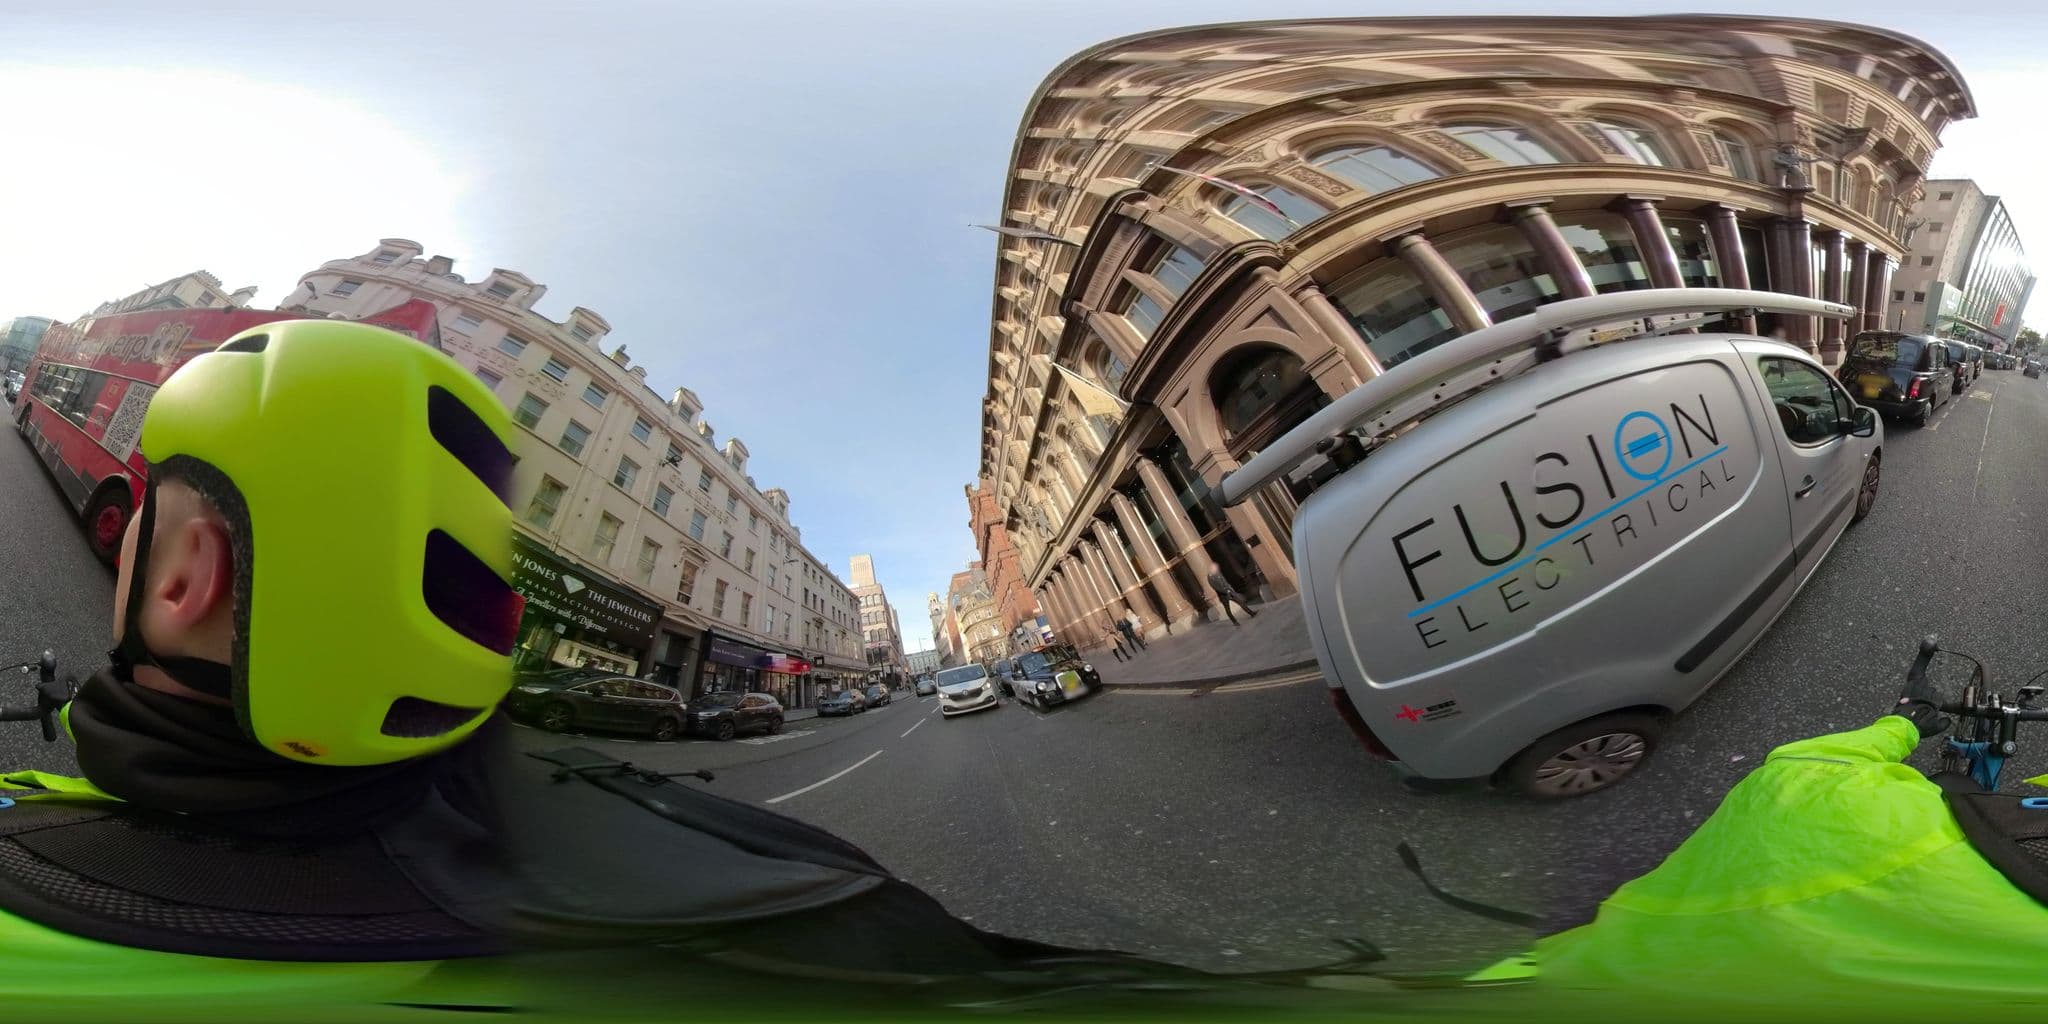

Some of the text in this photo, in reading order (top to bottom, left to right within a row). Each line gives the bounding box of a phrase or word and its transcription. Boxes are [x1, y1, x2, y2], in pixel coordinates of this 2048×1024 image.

[1391, 393, 1722, 602] FUSION
[1414, 458, 1736, 650] ELECTRICAL
[523, 558, 557, 581] JONES
[587, 589, 607, 604] THE
[607, 599, 652, 623] JEWELLERS
[526, 579, 641, 632] MANUFACTURE DESIGN
[526, 592, 557, 613] Jewellers
[576, 614, 608, 633] Difference
